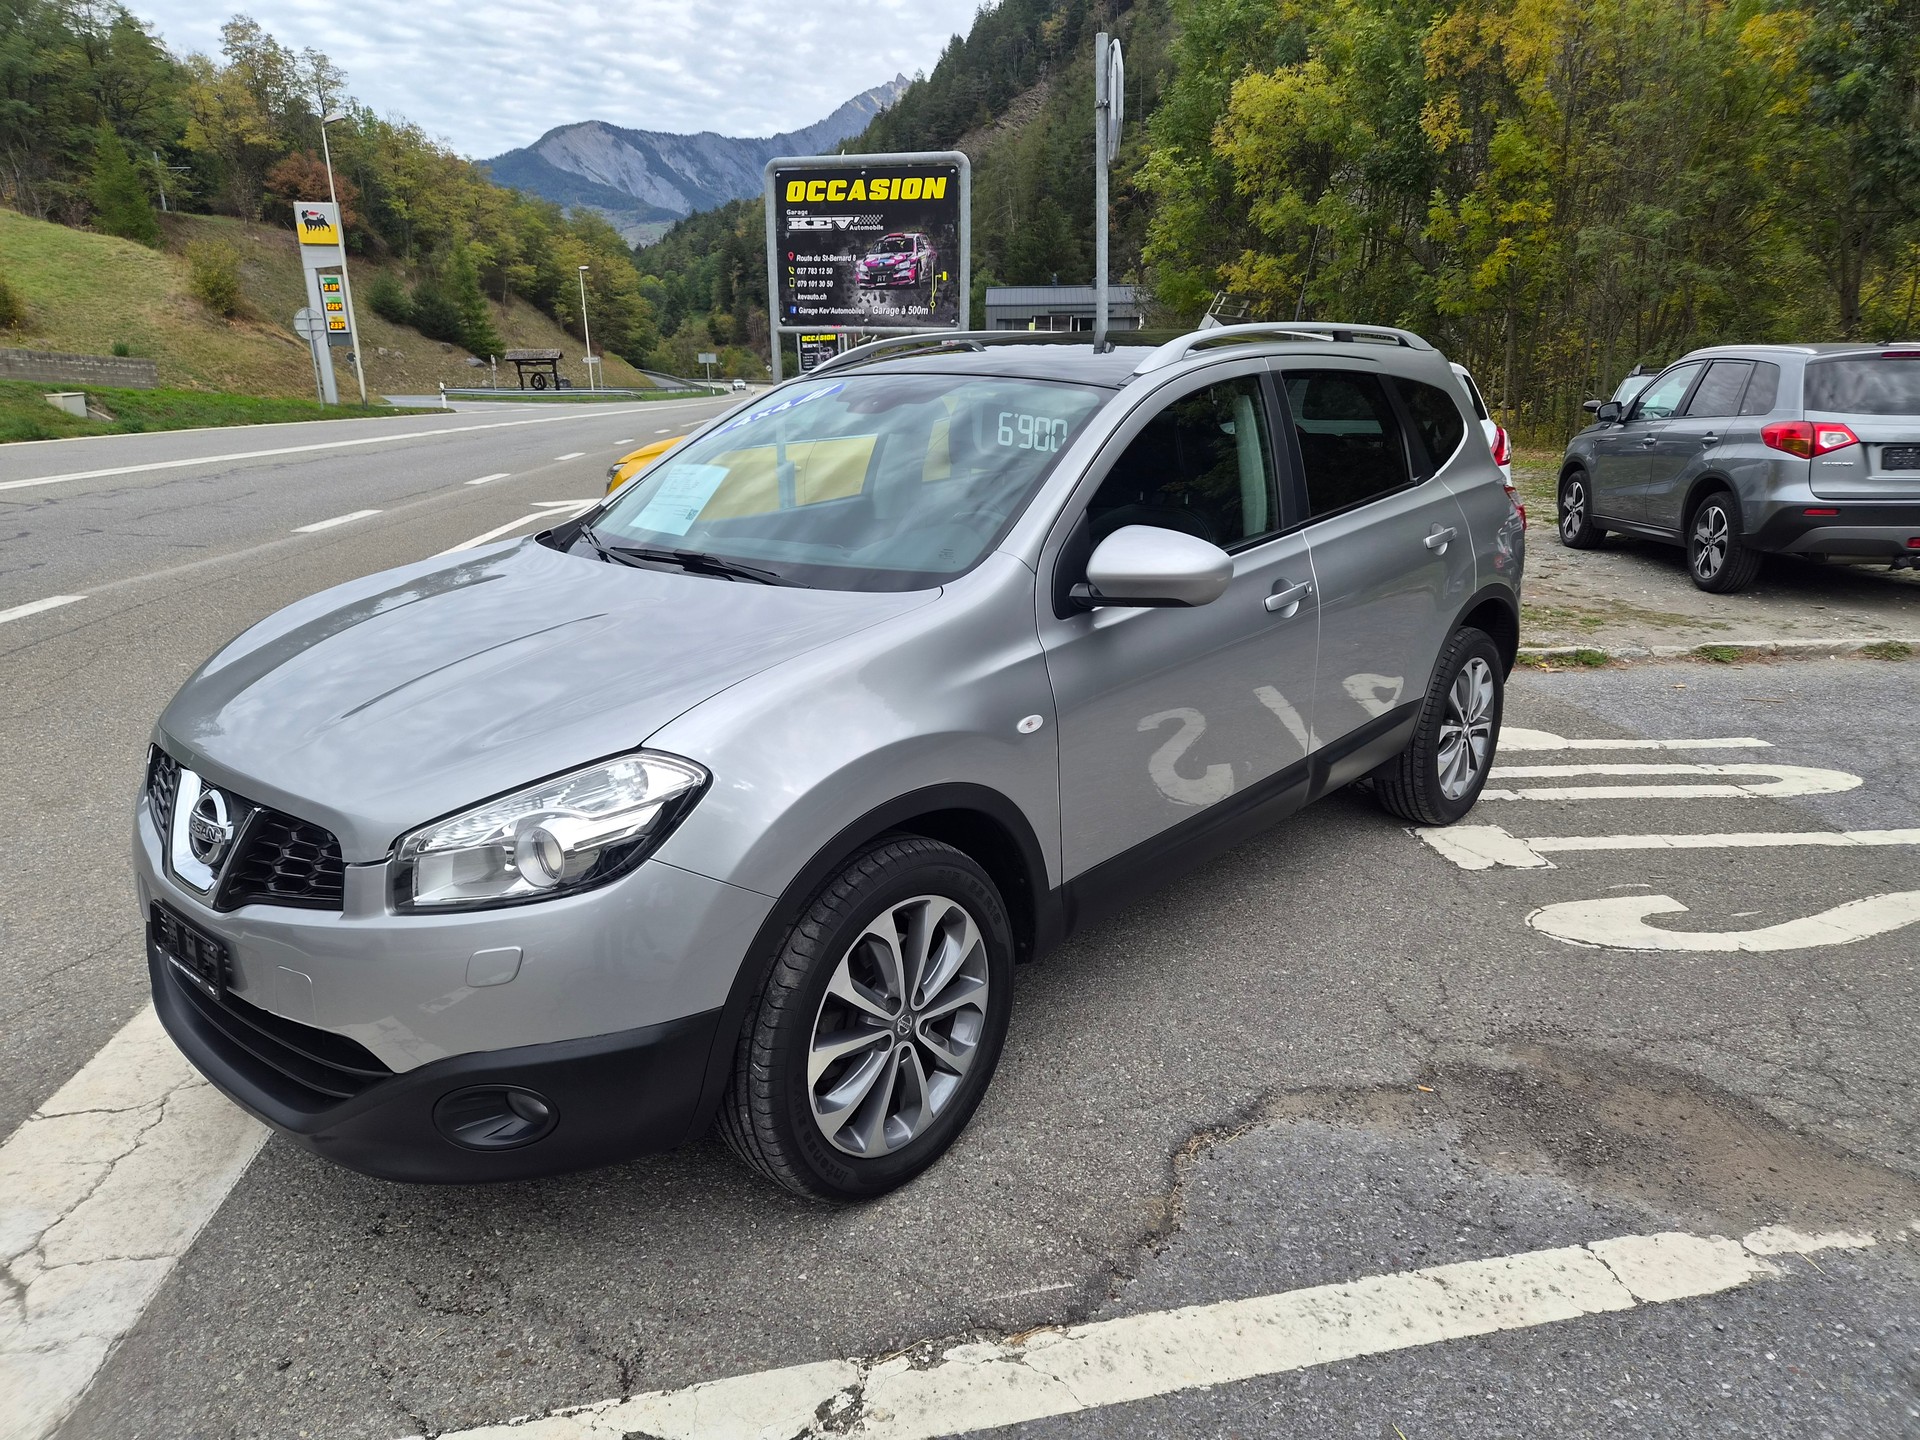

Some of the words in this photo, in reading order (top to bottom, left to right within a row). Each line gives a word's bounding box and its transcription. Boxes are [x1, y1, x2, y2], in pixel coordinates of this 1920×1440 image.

[786, 177, 946, 202] OCCASION
[798, 307, 818, 315] Garage
[873, 306, 899, 316] Garage
[901, 305, 906, 314] à
[908, 306, 928, 314] 500m
